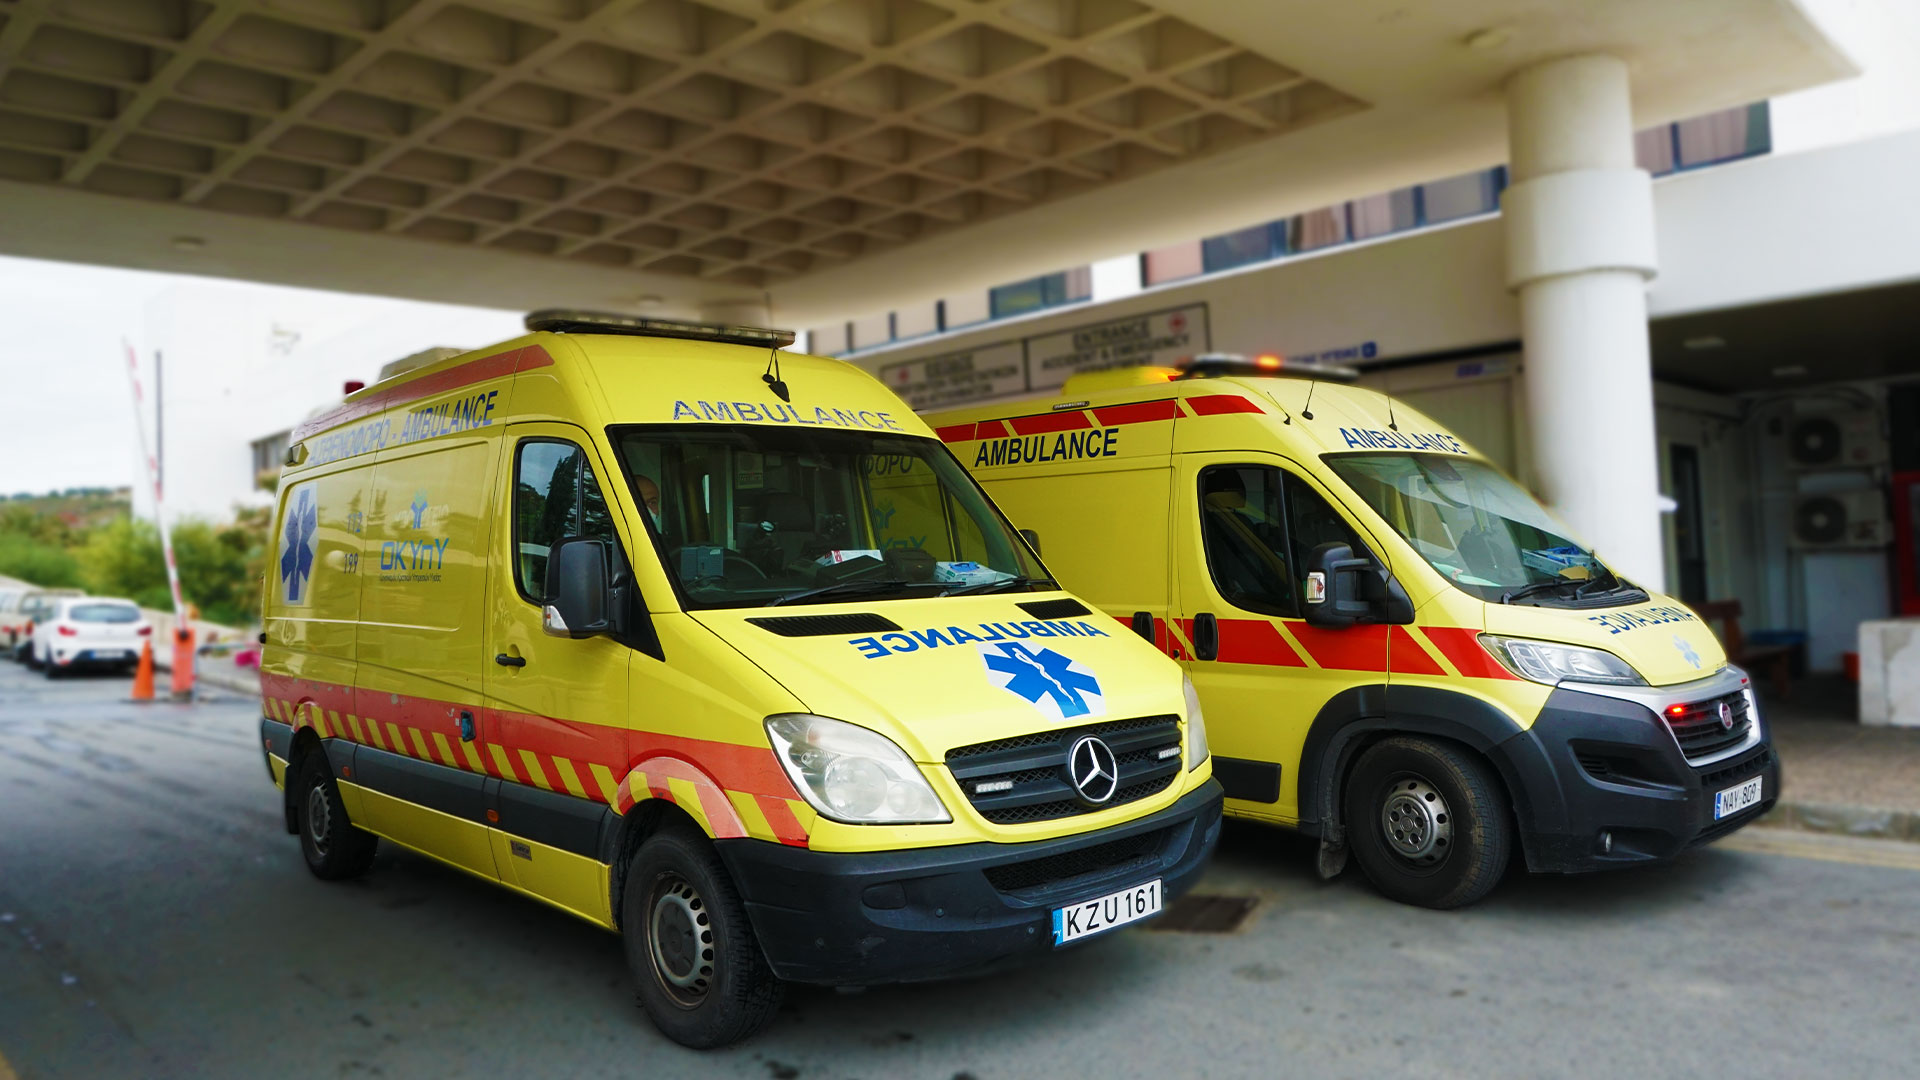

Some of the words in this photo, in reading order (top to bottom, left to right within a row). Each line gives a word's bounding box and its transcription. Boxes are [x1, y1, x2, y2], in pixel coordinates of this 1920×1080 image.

[400, 390, 499, 445] AMBULANCE
[673, 400, 905, 432] AMBULANCE
[974, 428, 1119, 467] AMBULANCE
[1339, 427, 1468, 455] AMBULANCE
[347, 511, 363, 534] 112
[343, 552, 358, 574] 199
[1722, 791, 1740, 813] NAY
[1067, 896, 1118, 936] KZU
[1125, 884, 1155, 918] 161
